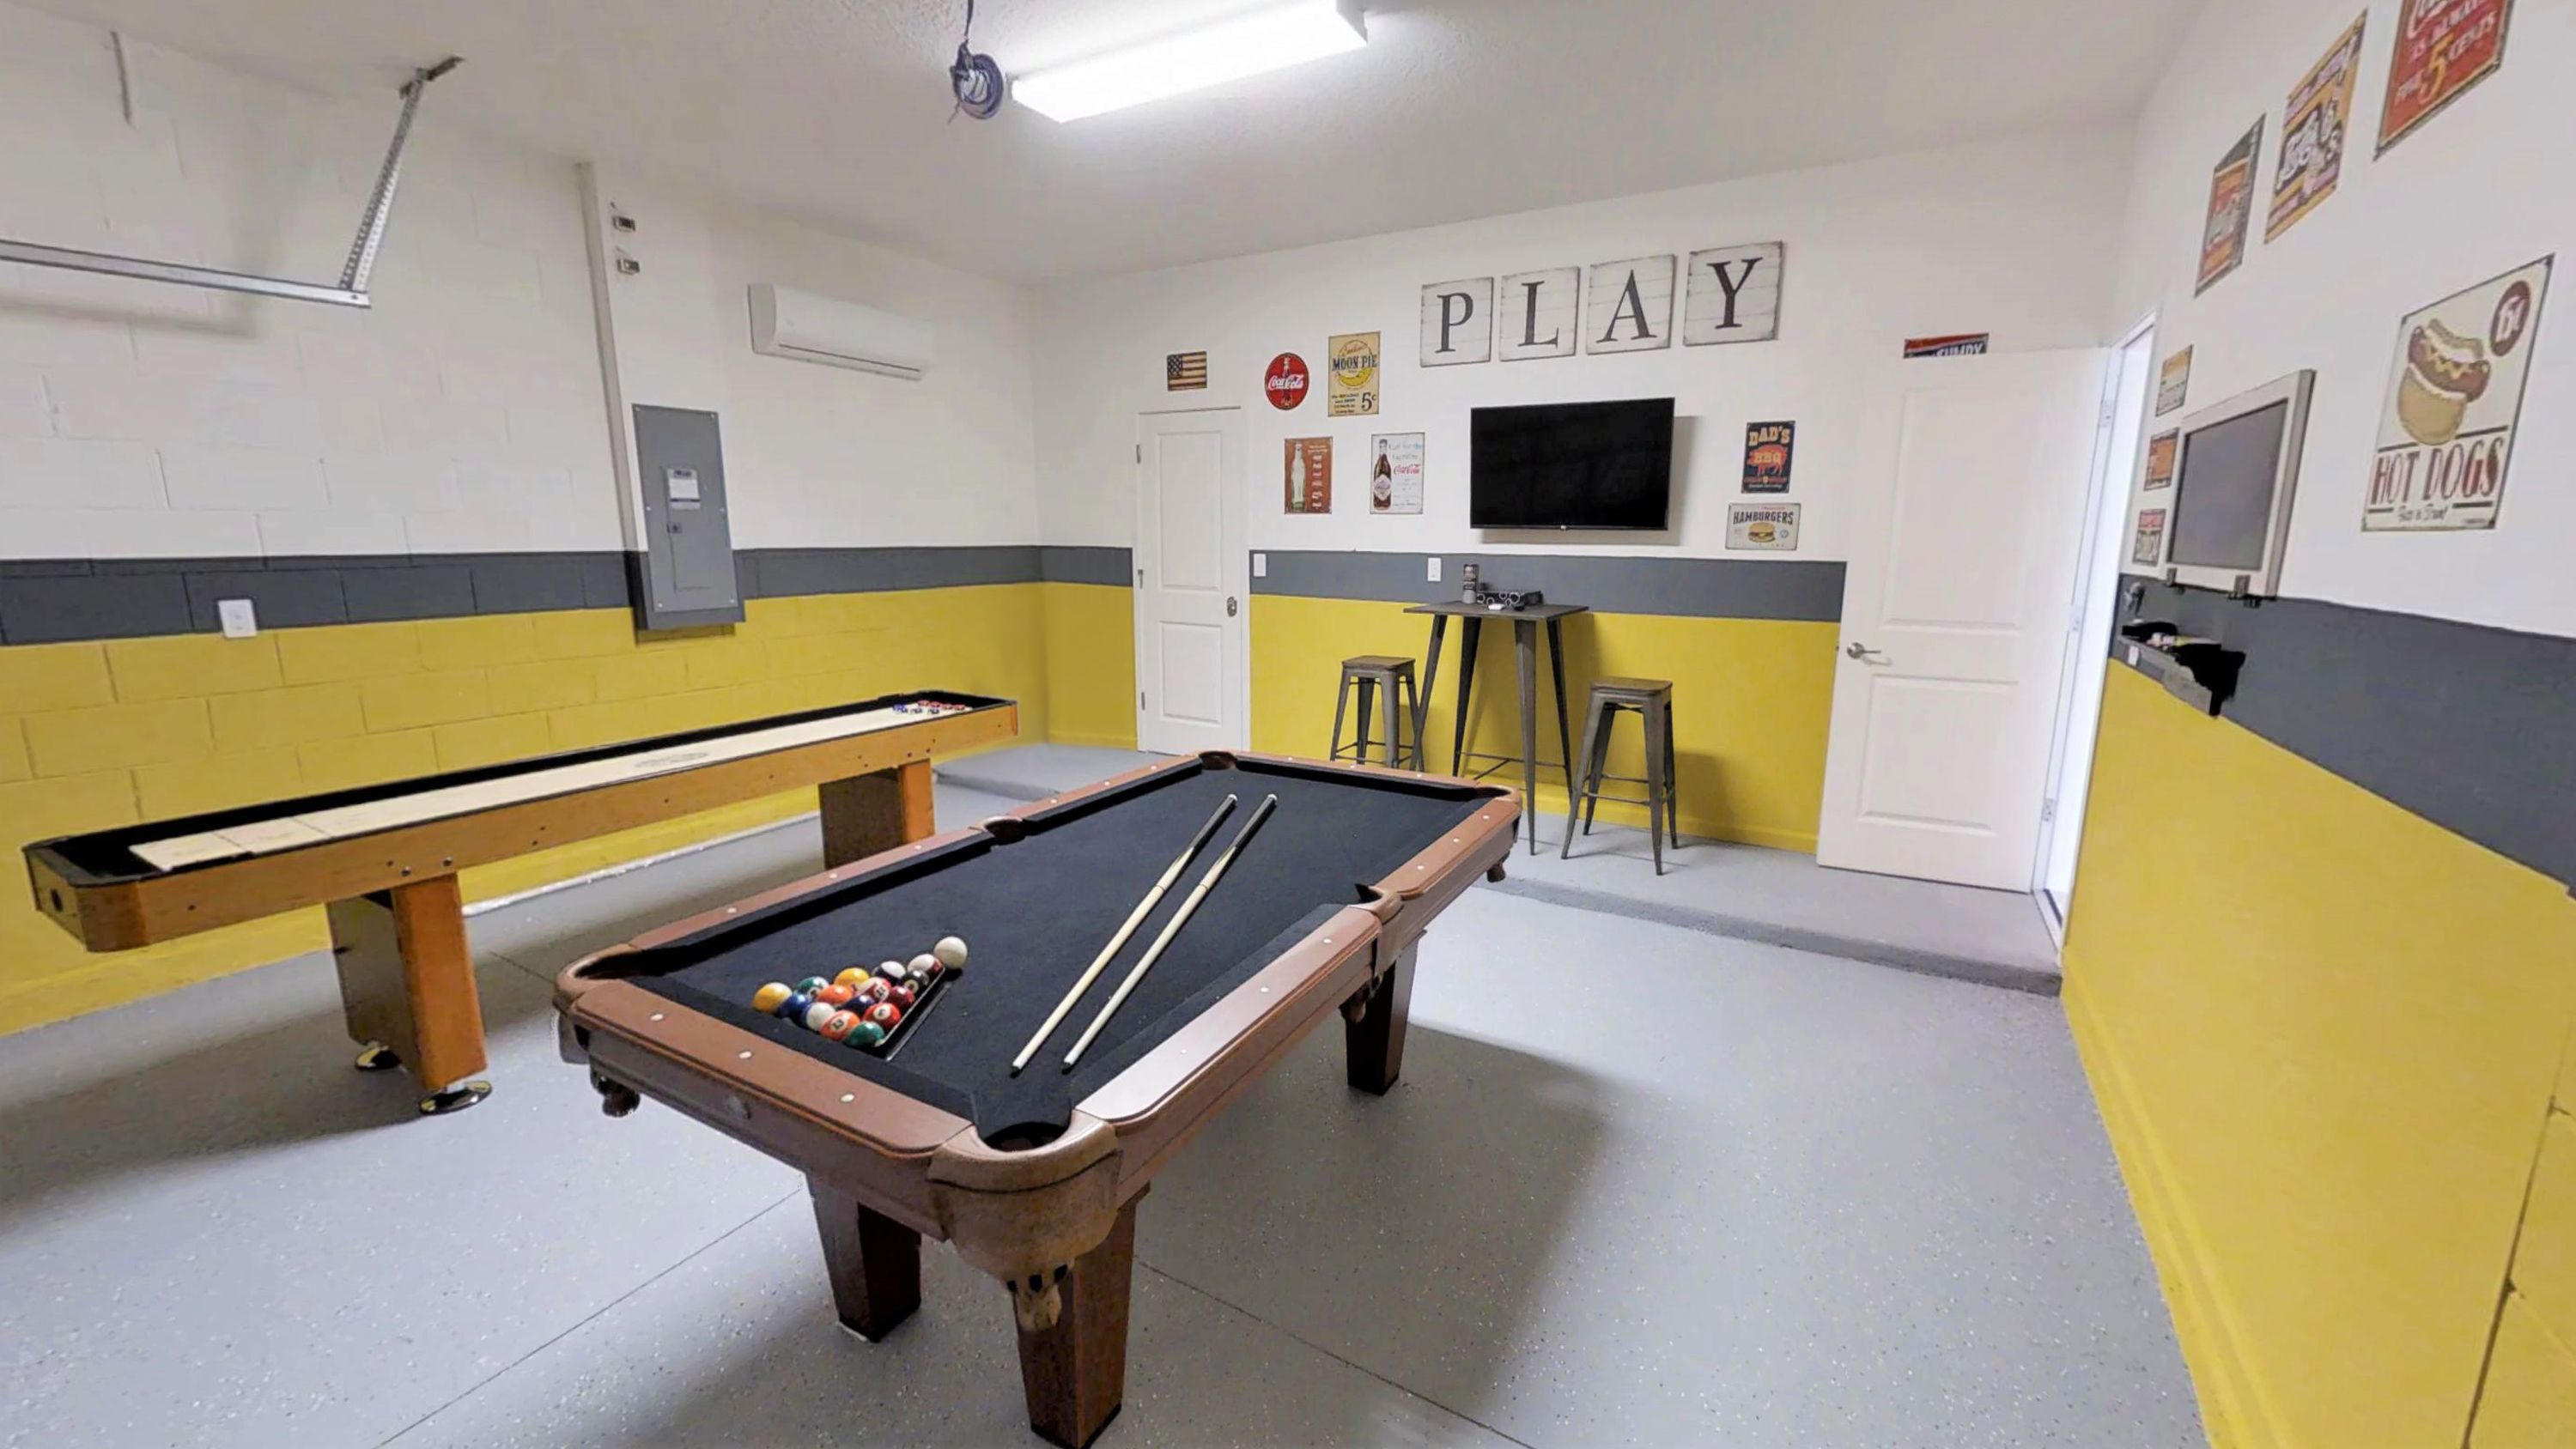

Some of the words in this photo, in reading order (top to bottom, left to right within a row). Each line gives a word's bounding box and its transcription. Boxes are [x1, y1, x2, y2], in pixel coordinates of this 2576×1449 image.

[2419, 31, 2455, 105] 5
[1332, 355, 1358, 372] MOON
[1361, 354, 1378, 368] PIE
[1748, 426, 1790, 446] DAD'S
[1754, 451, 1782, 464] BBQ
[2370, 450, 2420, 505] HOT
[2421, 436, 2505, 502] DOGS
[1733, 511, 1794, 524] HAMBURGERS
